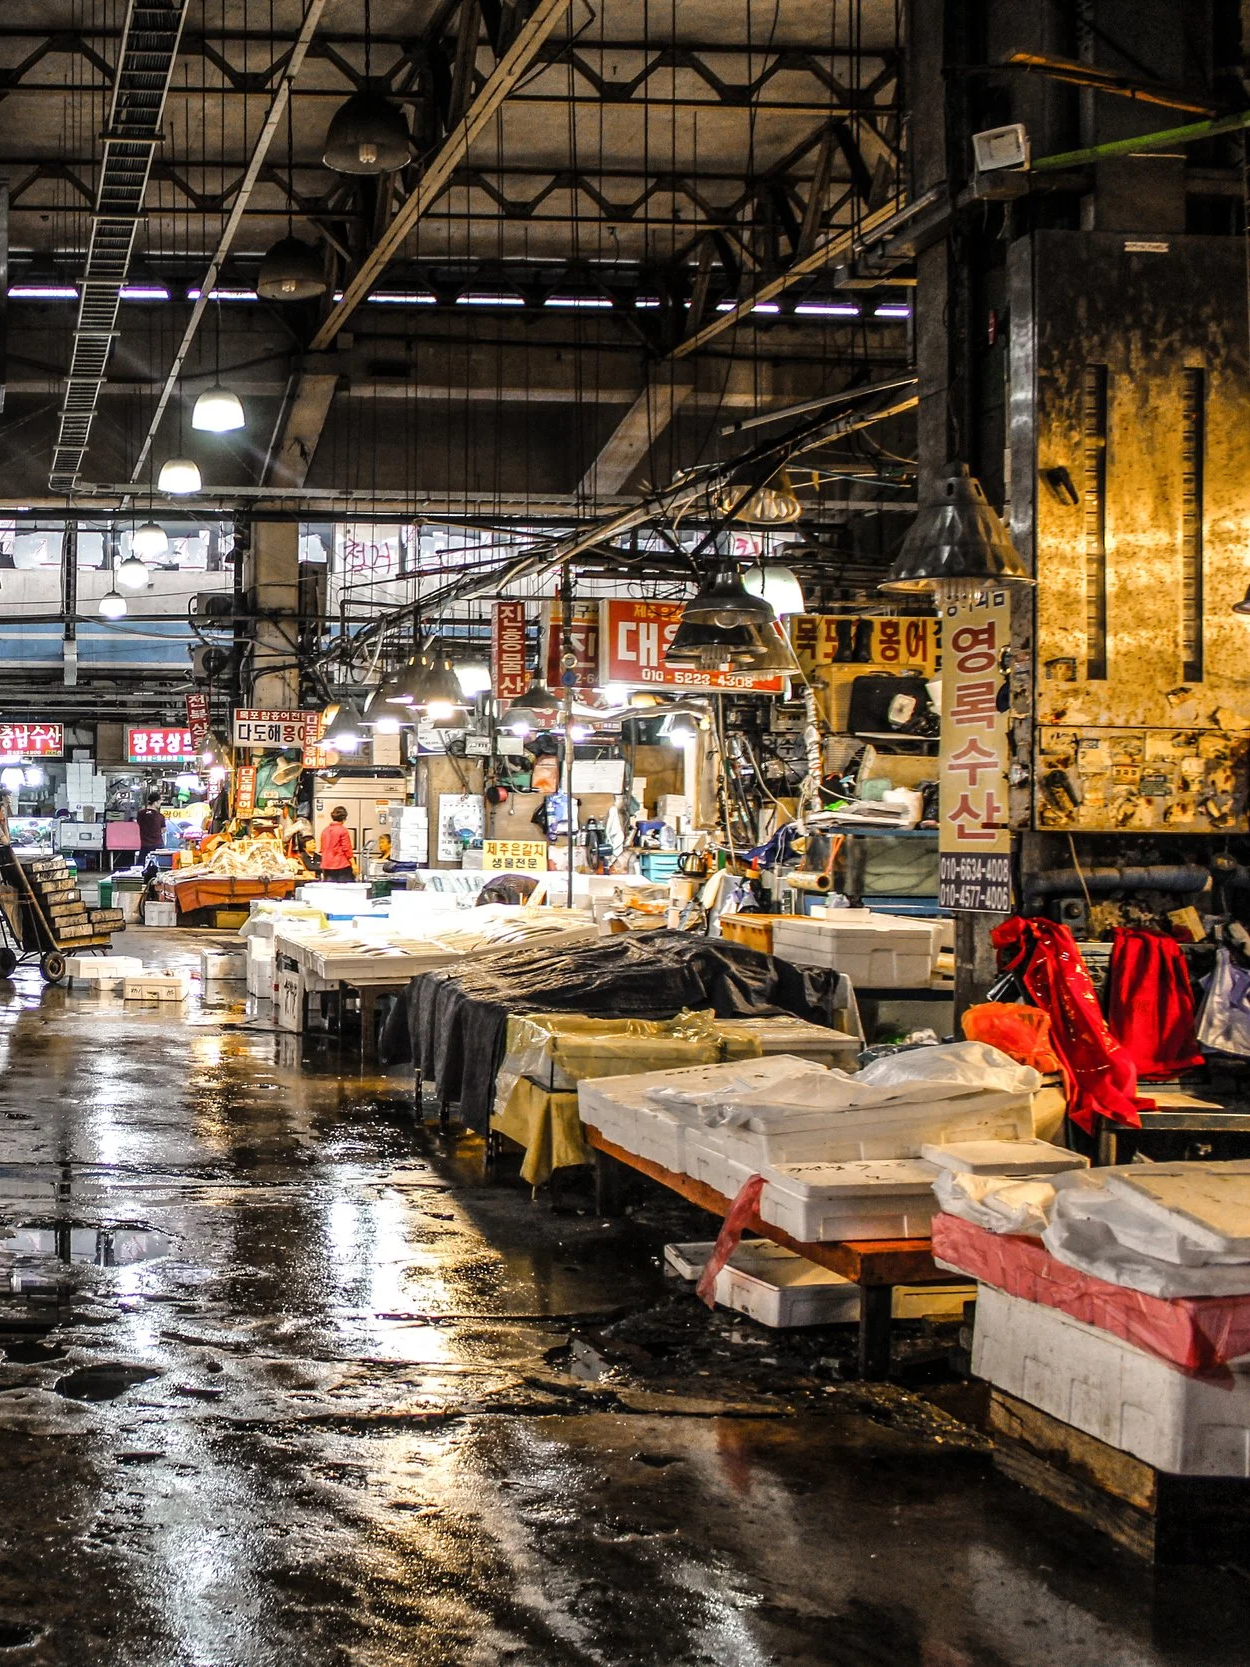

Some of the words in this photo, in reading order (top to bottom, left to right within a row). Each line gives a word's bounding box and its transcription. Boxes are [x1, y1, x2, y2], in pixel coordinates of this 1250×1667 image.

[500, 605, 524, 698] 진흥물산
[0, 725, 62, 749] 충남수산
[948, 621, 1002, 840] 영록수산
[487, 842, 544, 857] 제주은갈치
[491, 858, 538, 869] 생물전문
